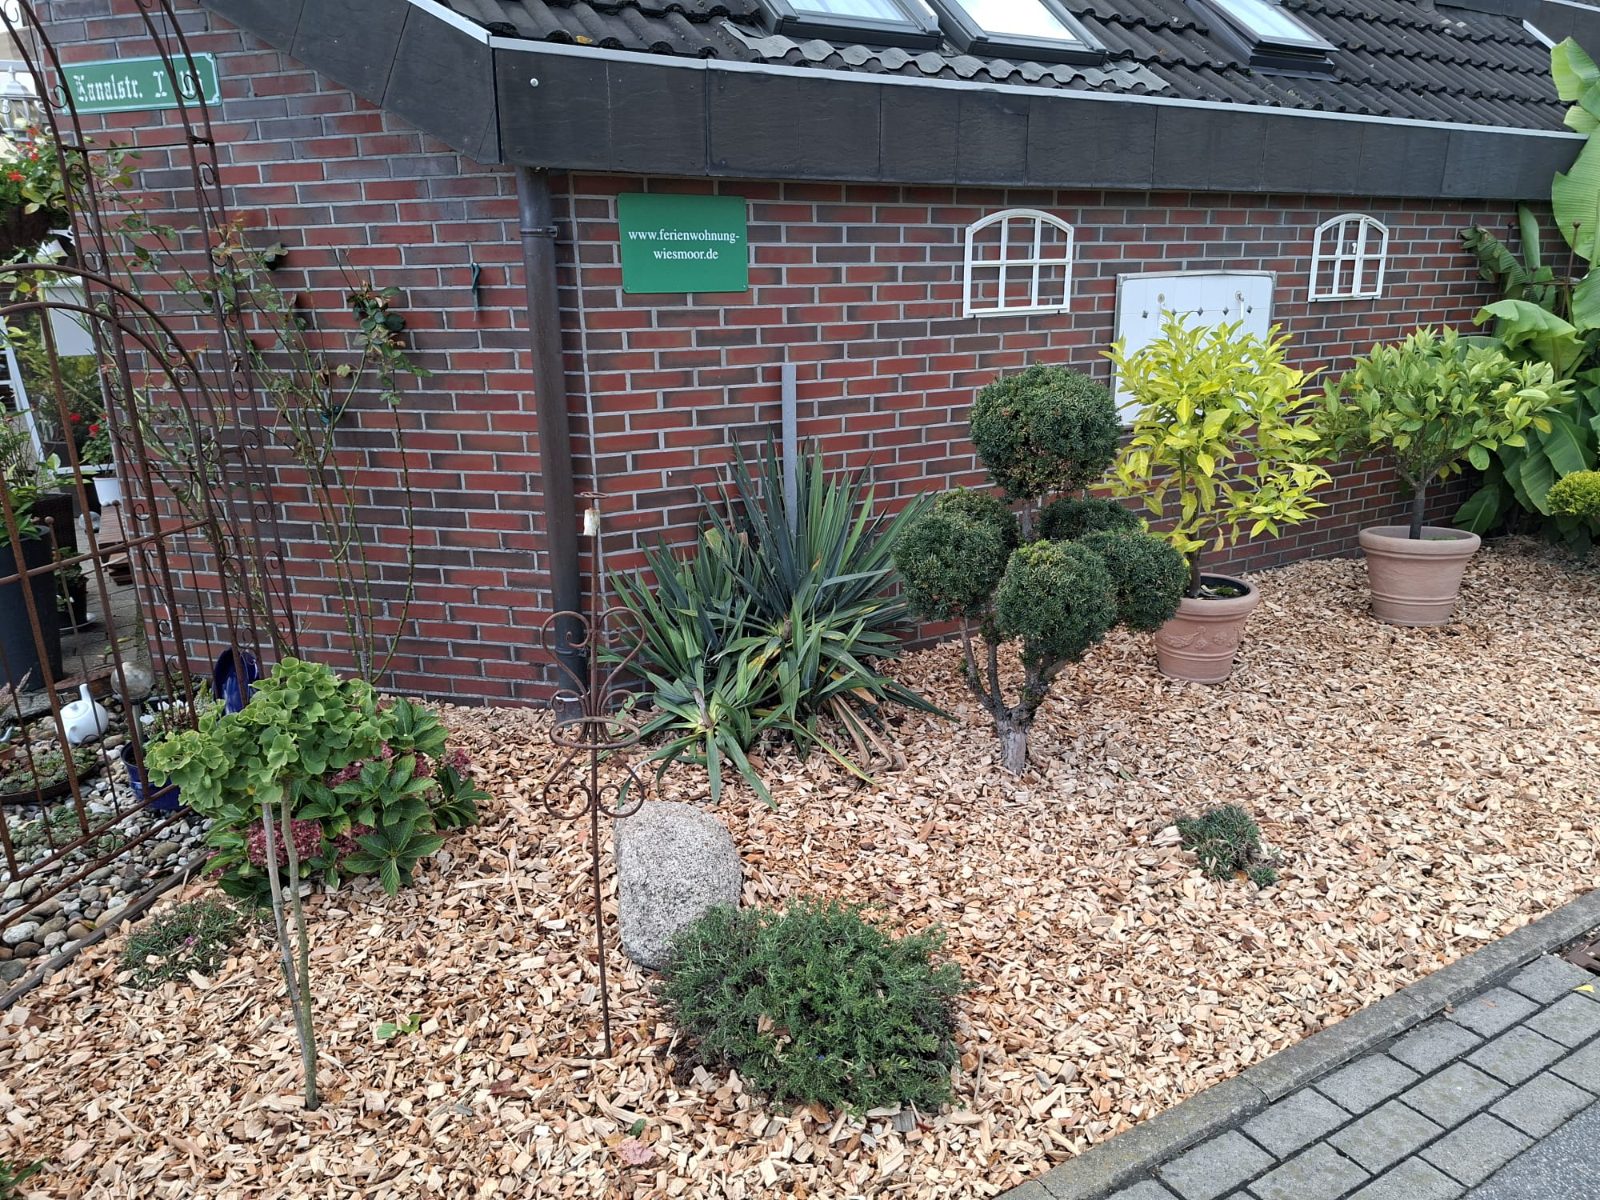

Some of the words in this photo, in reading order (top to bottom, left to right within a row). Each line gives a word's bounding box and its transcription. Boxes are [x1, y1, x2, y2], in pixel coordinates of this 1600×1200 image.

[73, 74, 143, 102] Kanalstr.
[628, 228, 740, 244] www.ferienwohnung-
[653, 247, 719, 260] wiesmoor.de
